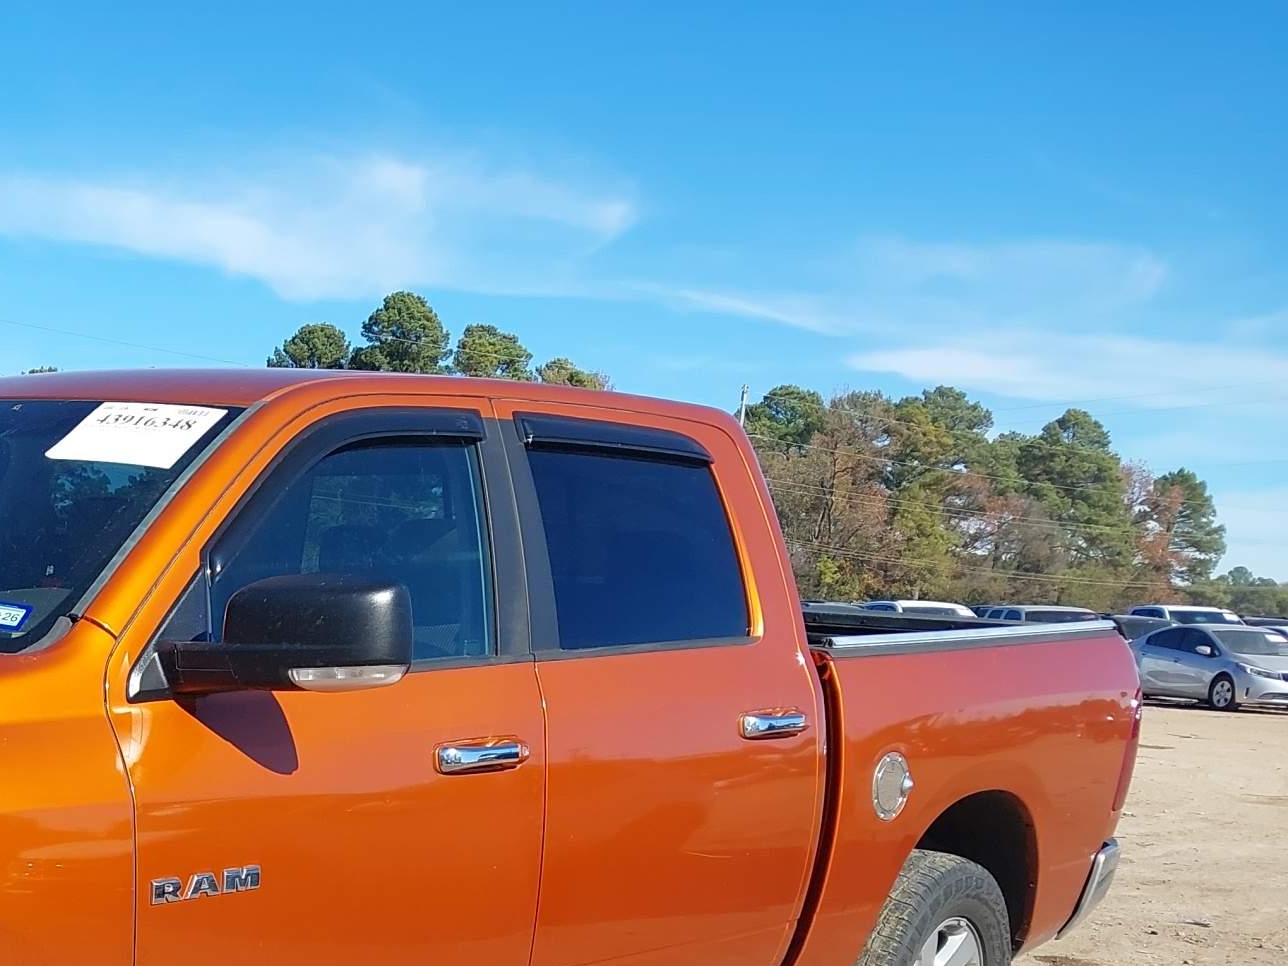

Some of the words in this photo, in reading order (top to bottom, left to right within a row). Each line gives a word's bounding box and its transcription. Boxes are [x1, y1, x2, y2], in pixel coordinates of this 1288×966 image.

[97, 414, 197, 430] 43916348
[2, 612, 20, 622] 26
[150, 864, 262, 905] RAM
